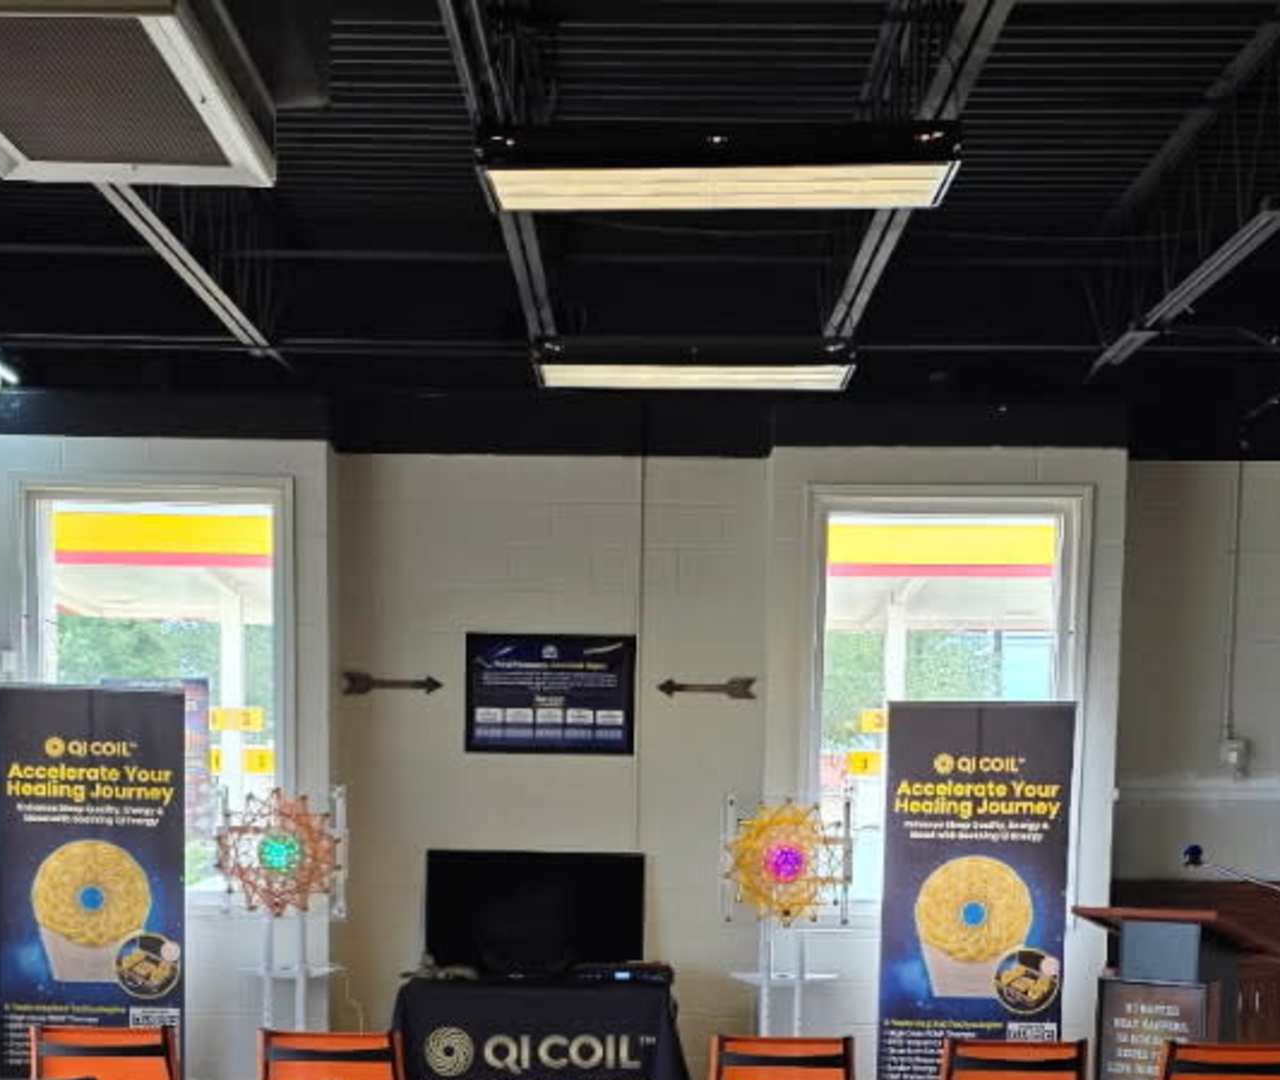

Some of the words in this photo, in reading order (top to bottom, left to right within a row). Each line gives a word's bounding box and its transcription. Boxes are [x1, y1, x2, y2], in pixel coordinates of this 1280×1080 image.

[7, 762, 120, 782] Accelerate
[124, 765, 172, 783] Your
[6, 780, 86, 802] Healing
[90, 783, 174, 806] Journey
[896, 779, 1008, 798] Accelerate
[1011, 780, 1061, 798] Your
[894, 797, 972, 819] Healing
[976, 799, 1061, 819] Journey
[483, 1034, 530, 1074] QI
